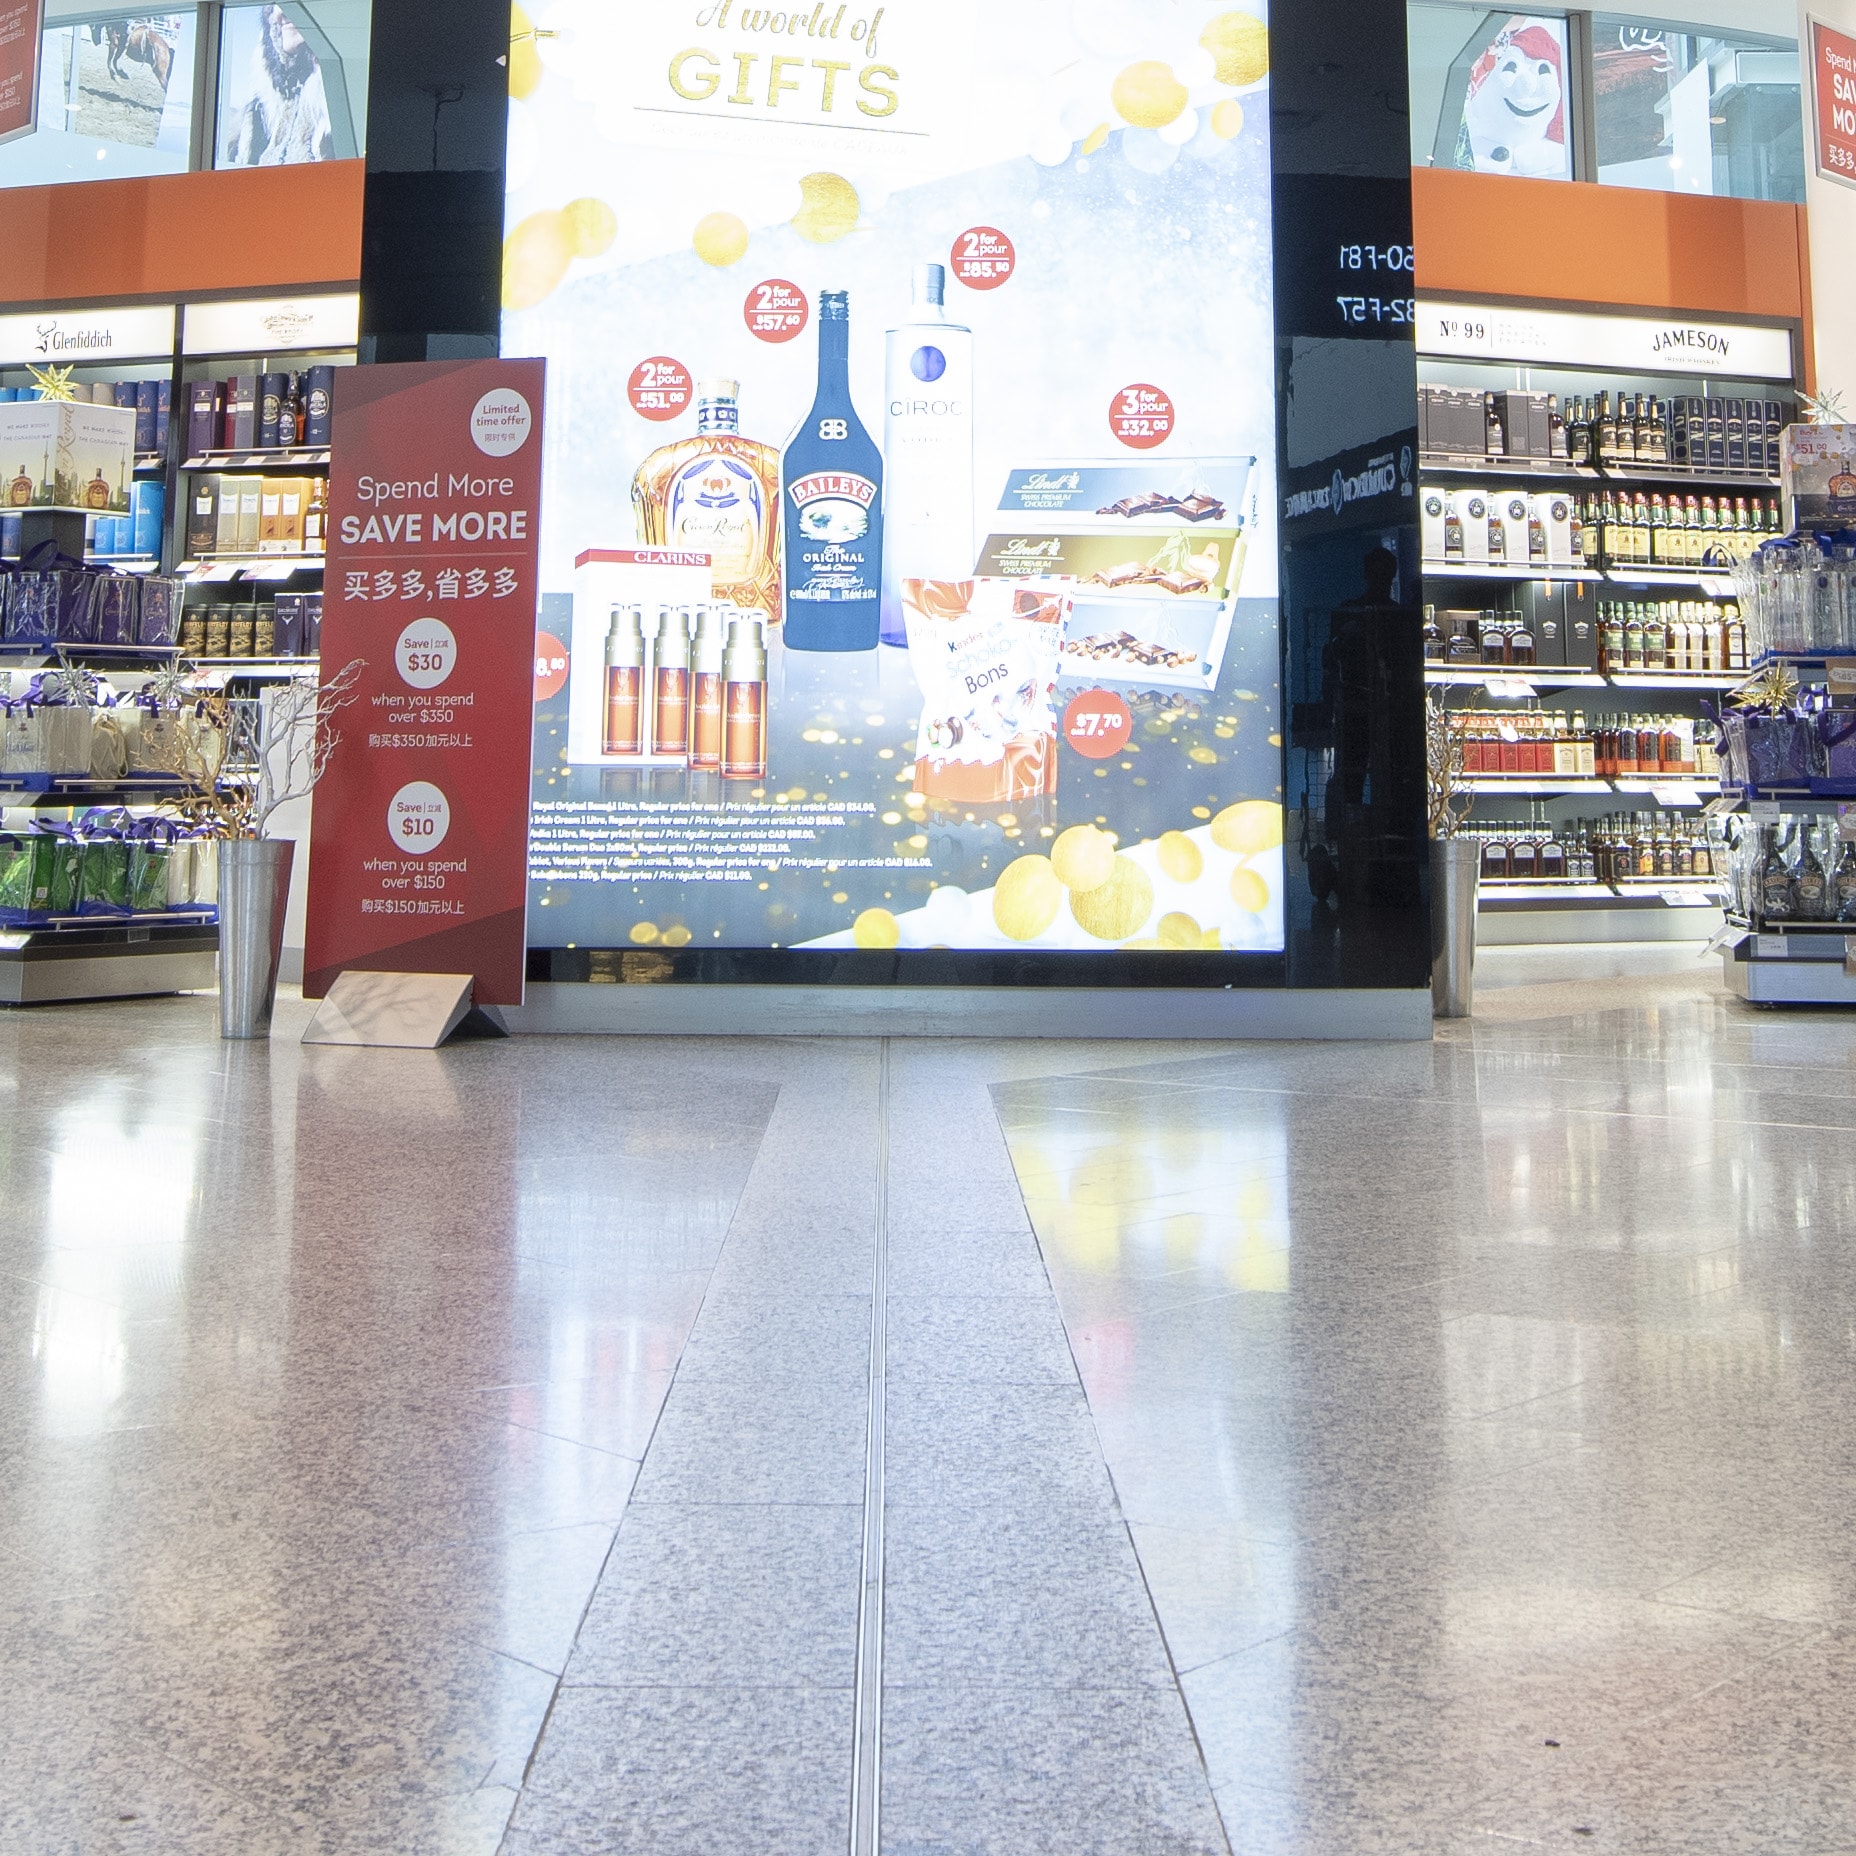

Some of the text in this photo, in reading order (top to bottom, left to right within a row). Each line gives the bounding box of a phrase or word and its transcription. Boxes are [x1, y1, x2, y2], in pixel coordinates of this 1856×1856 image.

[740, 1, 847, 40] world
[850, 6, 885, 58] of
[1825, 46, 1851, 70] Spend
[667, 46, 900, 118] GIFTS
[962, 232, 998, 257] 2 for
[979, 244, 1008, 256] pour
[756, 285, 792, 310] 2 for
[772, 297, 802, 310] pour
[52, 328, 112, 350] Glenfiddich
[1464, 322, 1485, 339] 99
[1652, 329, 1730, 356] JAMESON
[641, 361, 676, 388] 2 for
[657, 374, 686, 387] pour
[482, 403, 520, 415] Limited
[1121, 389, 1158, 415] 3 for
[1139, 402, 1169, 414] pour
[476, 416, 526, 427] time offer
[356, 472, 514, 508] Spend More
[795, 475, 872, 502] BAILEYS
[1021, 473, 1069, 491] Lindt
[341, 510, 528, 545] SAVE MORE
[999, 538, 1049, 556] Lindt
[633, 550, 707, 566] CLARINS
[802, 551, 865, 563] ORIGINAL
[343, 566, 519, 602] 买多多,省多多
[403, 638, 429, 649] Save
[407, 653, 443, 672] $30
[964, 663, 1009, 694] Bons
[371, 692, 474, 710] when you spend
[388, 708, 454, 725] over $350
[396, 802, 422, 814] Save
[401, 818, 434, 837] $10
[363, 858, 467, 875] when you spend
[381, 874, 445, 891] over $150
